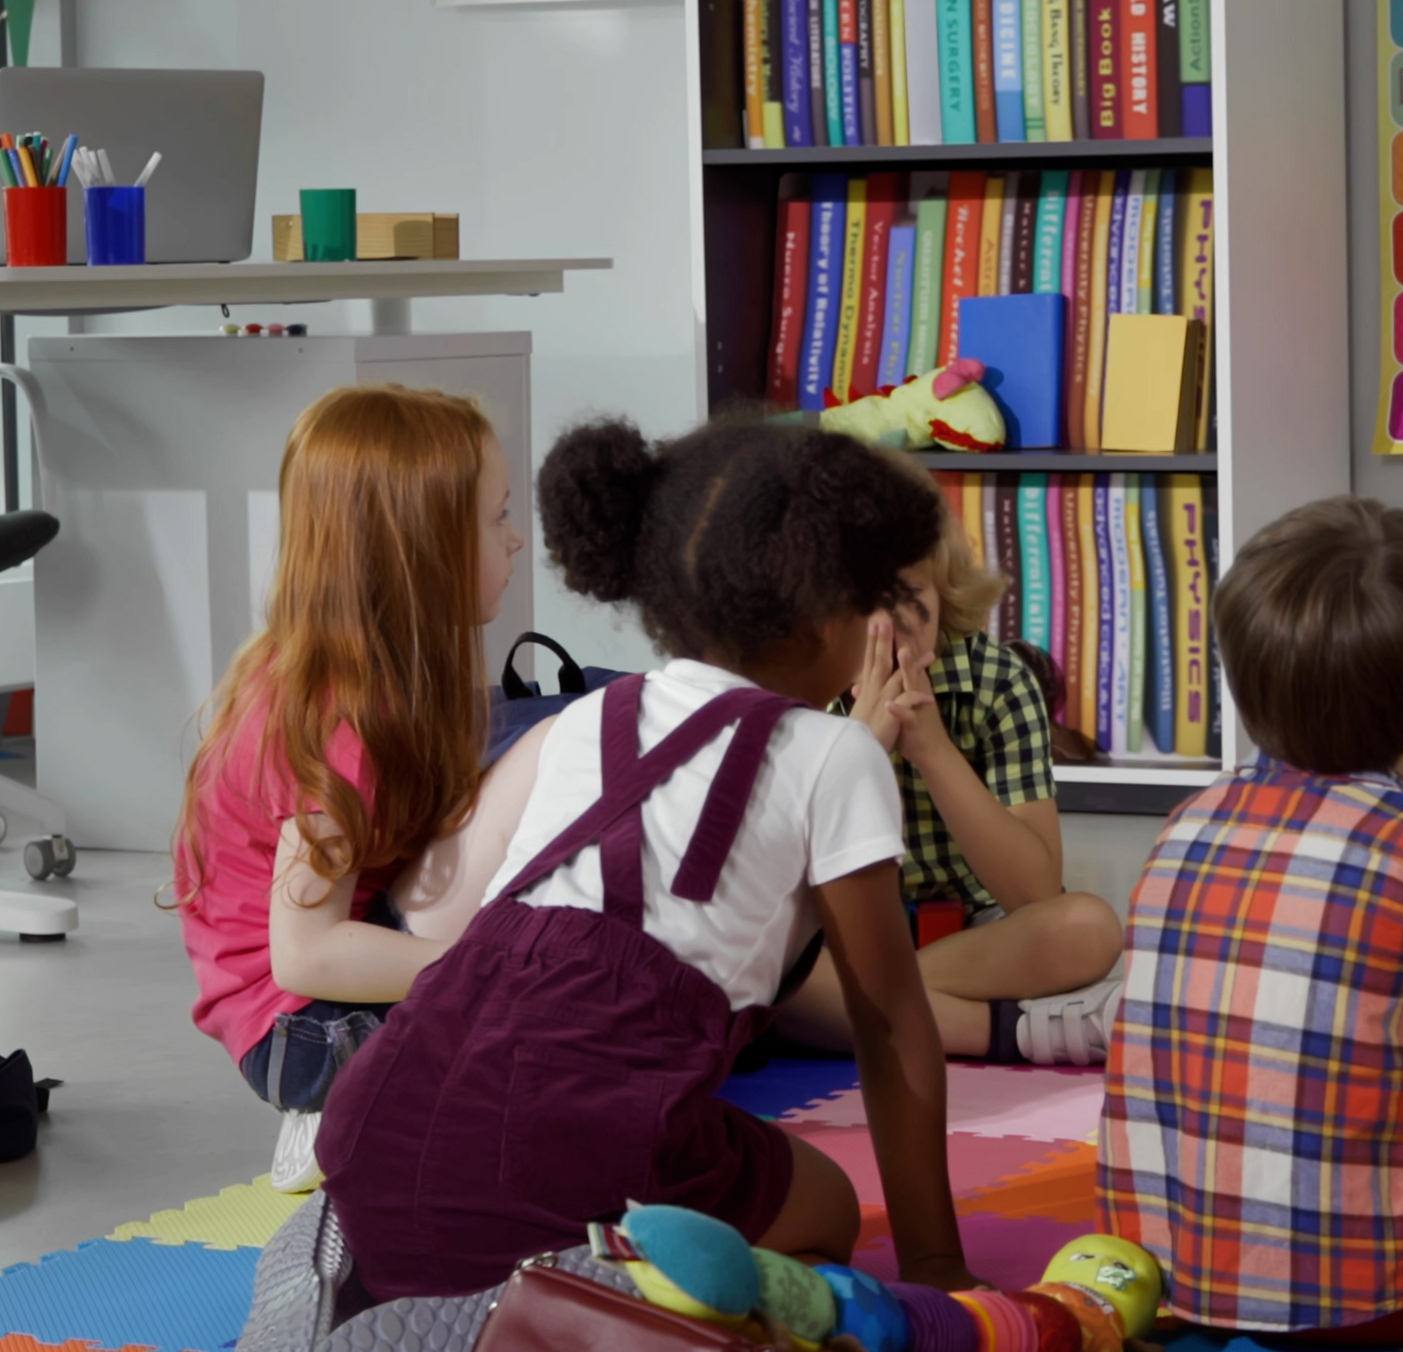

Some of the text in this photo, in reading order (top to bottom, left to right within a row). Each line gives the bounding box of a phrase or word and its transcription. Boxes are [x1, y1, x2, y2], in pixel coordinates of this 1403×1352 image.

[810, 17, 820, 88] LITERATURE
[825, 36, 838, 120] BIOLOGY
[947, 19, 961, 112] SURGERY
[1000, 2, 1016, 79] DICINE
[1097, 8, 1116, 127] Big Book
[1131, 32, 1148, 114] HISTORY
[842, 48, 855, 136] POLITICS
[846, 219, 861, 300] Thermo
[1019, 202, 1031, 270] Matter
[1162, 207, 1173, 299] Tutorials
[806, 202, 834, 395] Theory of Relativity
[862, 221, 884, 365] Vector Analysis
[1075, 194, 1094, 384] University Physics
[888, 341, 901, 385] Phy
[1003, 499, 1014, 568] Matter
[1007, 594, 1016, 638] Anti
[1067, 492, 1081, 684] University Physics
[1095, 487, 1112, 733] advanced calculus
[1146, 510, 1172, 710] Illustrator Tutorials
[1183, 502, 1202, 724] PHYSICS
